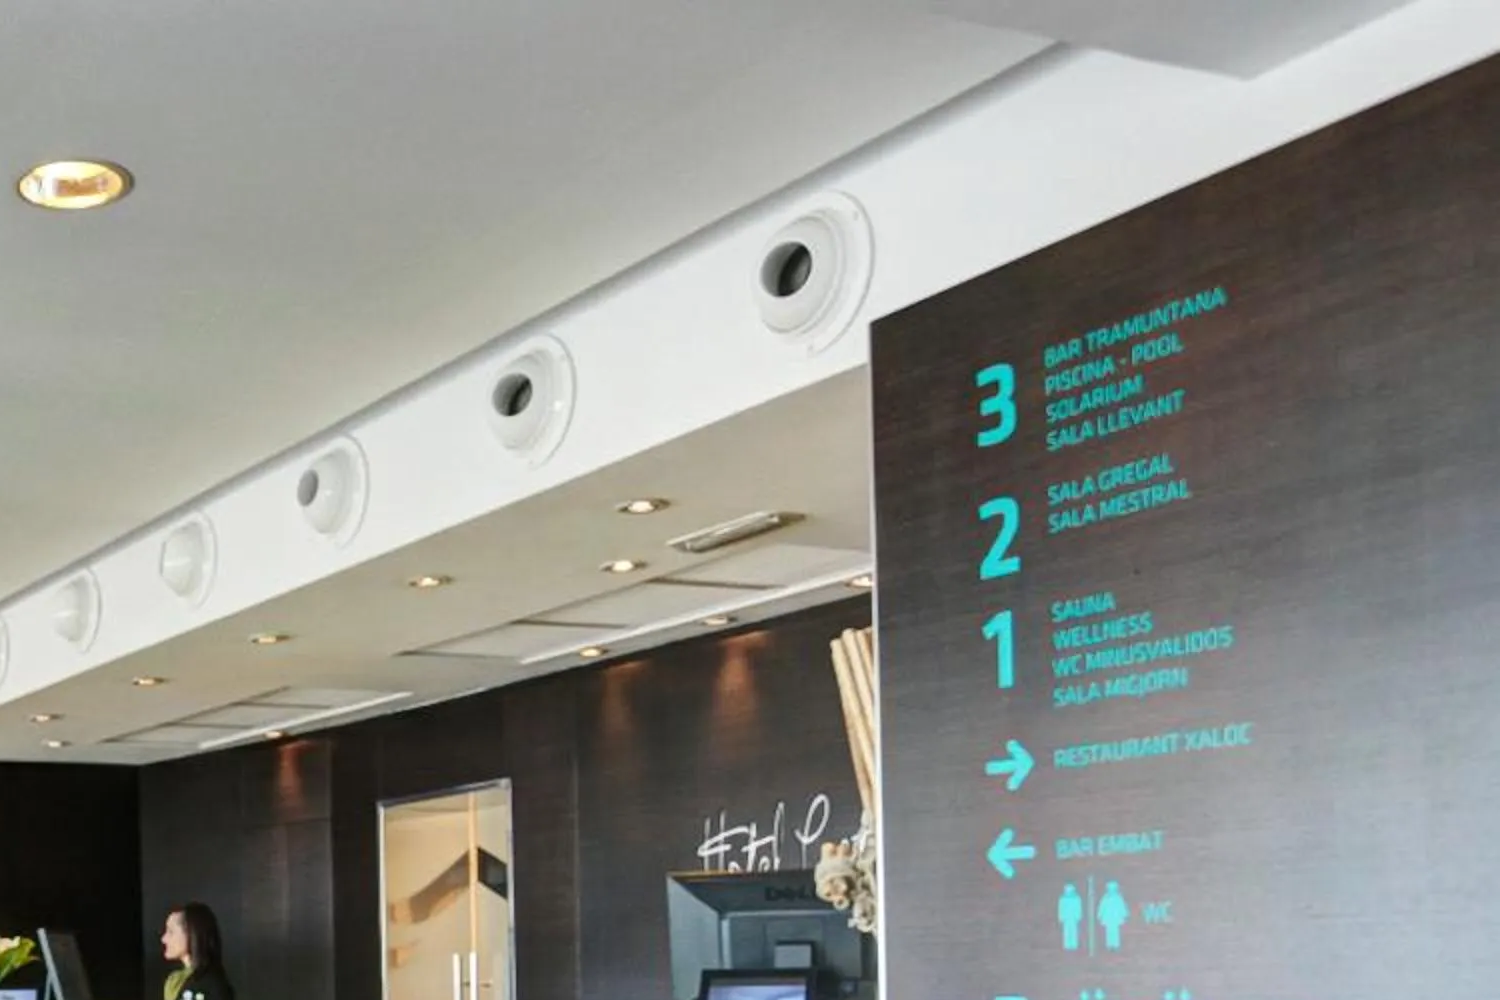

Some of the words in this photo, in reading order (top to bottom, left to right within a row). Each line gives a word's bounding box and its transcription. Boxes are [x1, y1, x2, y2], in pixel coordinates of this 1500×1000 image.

[1043, 341, 1082, 369] BAR
[1085, 286, 1229, 353] TRAMUNTANA
[1044, 357, 1115, 396] PISCINA
[1131, 332, 1185, 365] POOL
[974, 362, 1019, 448] 3
[1046, 373, 1145, 425] SOLARIUM
[1046, 421, 1095, 451] SALA
[1097, 388, 1186, 436] LLEVANT
[1047, 475, 1095, 506] SALA
[1099, 453, 1175, 491] GREGAL
[1047, 505, 1096, 534] SALA
[1099, 479, 1192, 518] MESTRAL
[977, 494, 1022, 581] 2
[1050, 592, 1117, 623] SAUNA
[1051, 611, 1154, 650] WELLNESS
[981, 608, 1017, 690] 1
[1051, 652, 1082, 678] WC
[1085, 626, 1235, 671] MINUSVALIDOS
[1052, 679, 1101, 706] SALA
[1105, 667, 1189, 700] MIGJORN
[1053, 732, 1179, 769] RESTAURANT
[1185, 722, 1255, 753] XALOC
[1055, 836, 1094, 861] BAR
[1097, 830, 1166, 858] EMBAT
[1141, 901, 1176, 925] WC
